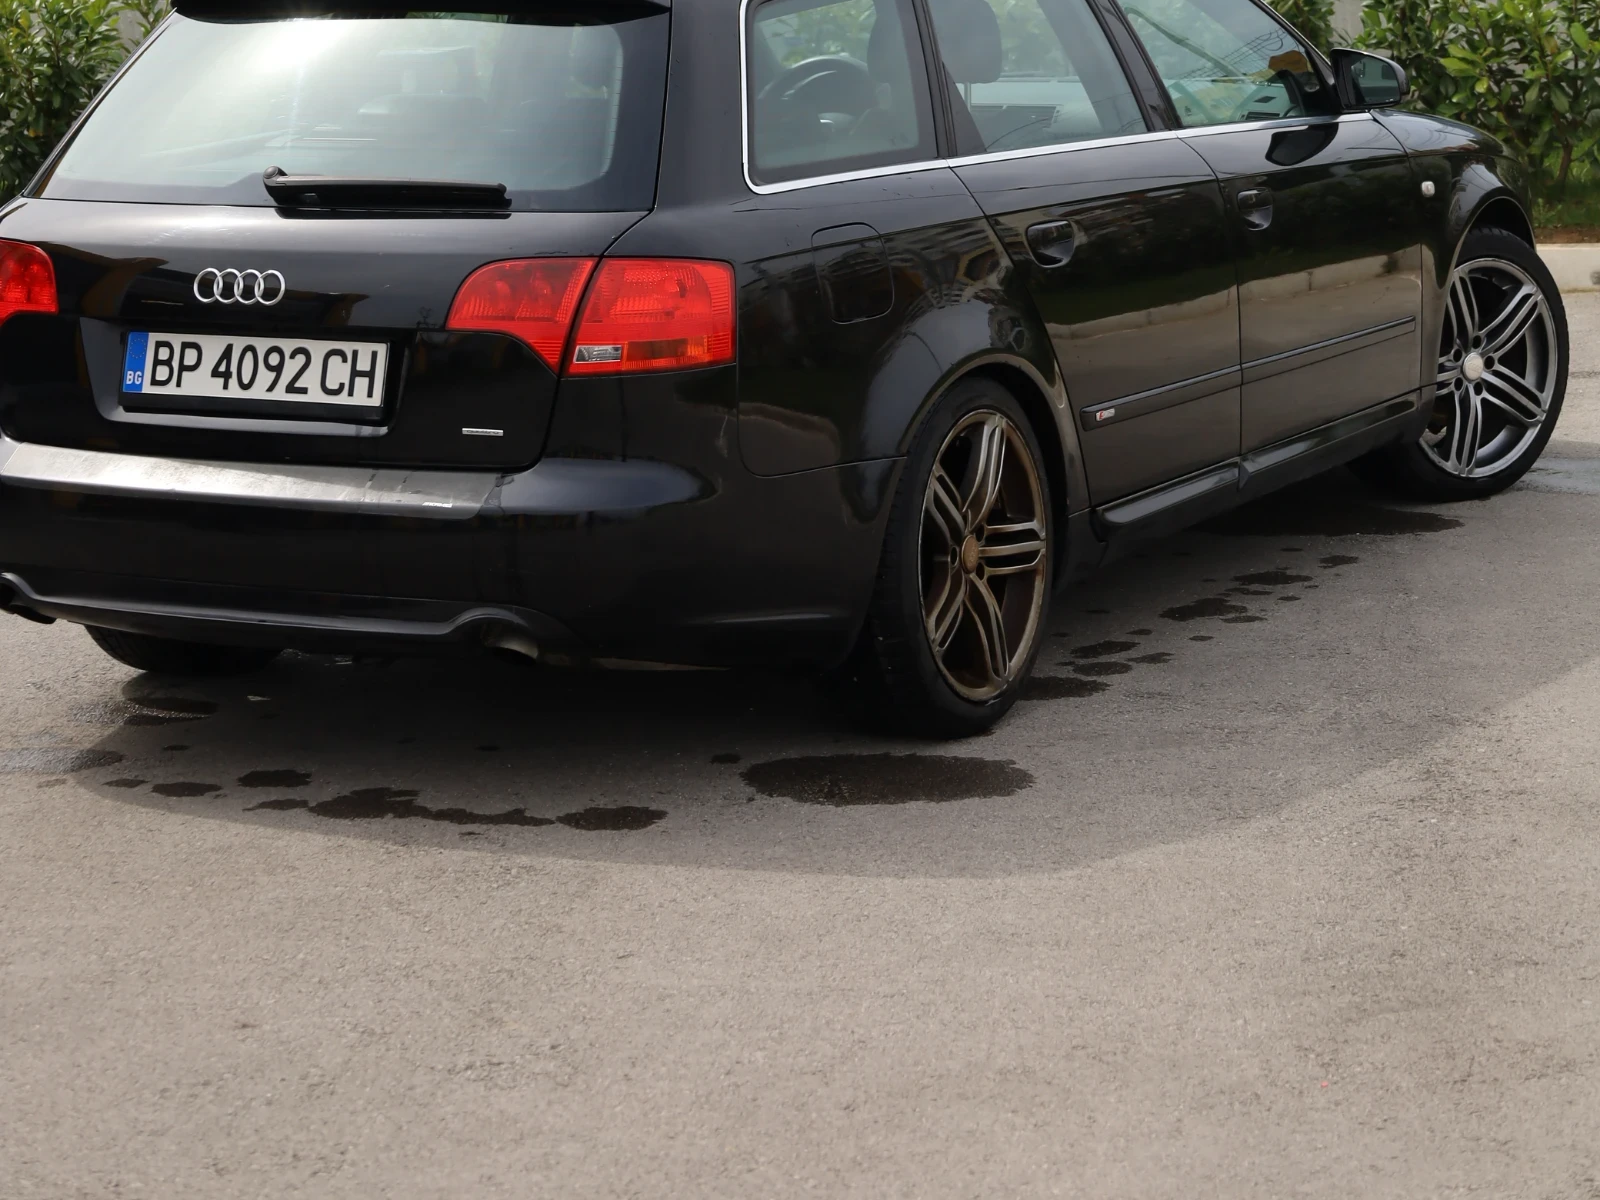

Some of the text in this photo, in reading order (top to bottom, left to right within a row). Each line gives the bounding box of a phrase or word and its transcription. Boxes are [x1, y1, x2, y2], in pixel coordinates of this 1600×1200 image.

[126, 371, 142, 384] BG
[150, 340, 378, 398] BP 4092 CH
